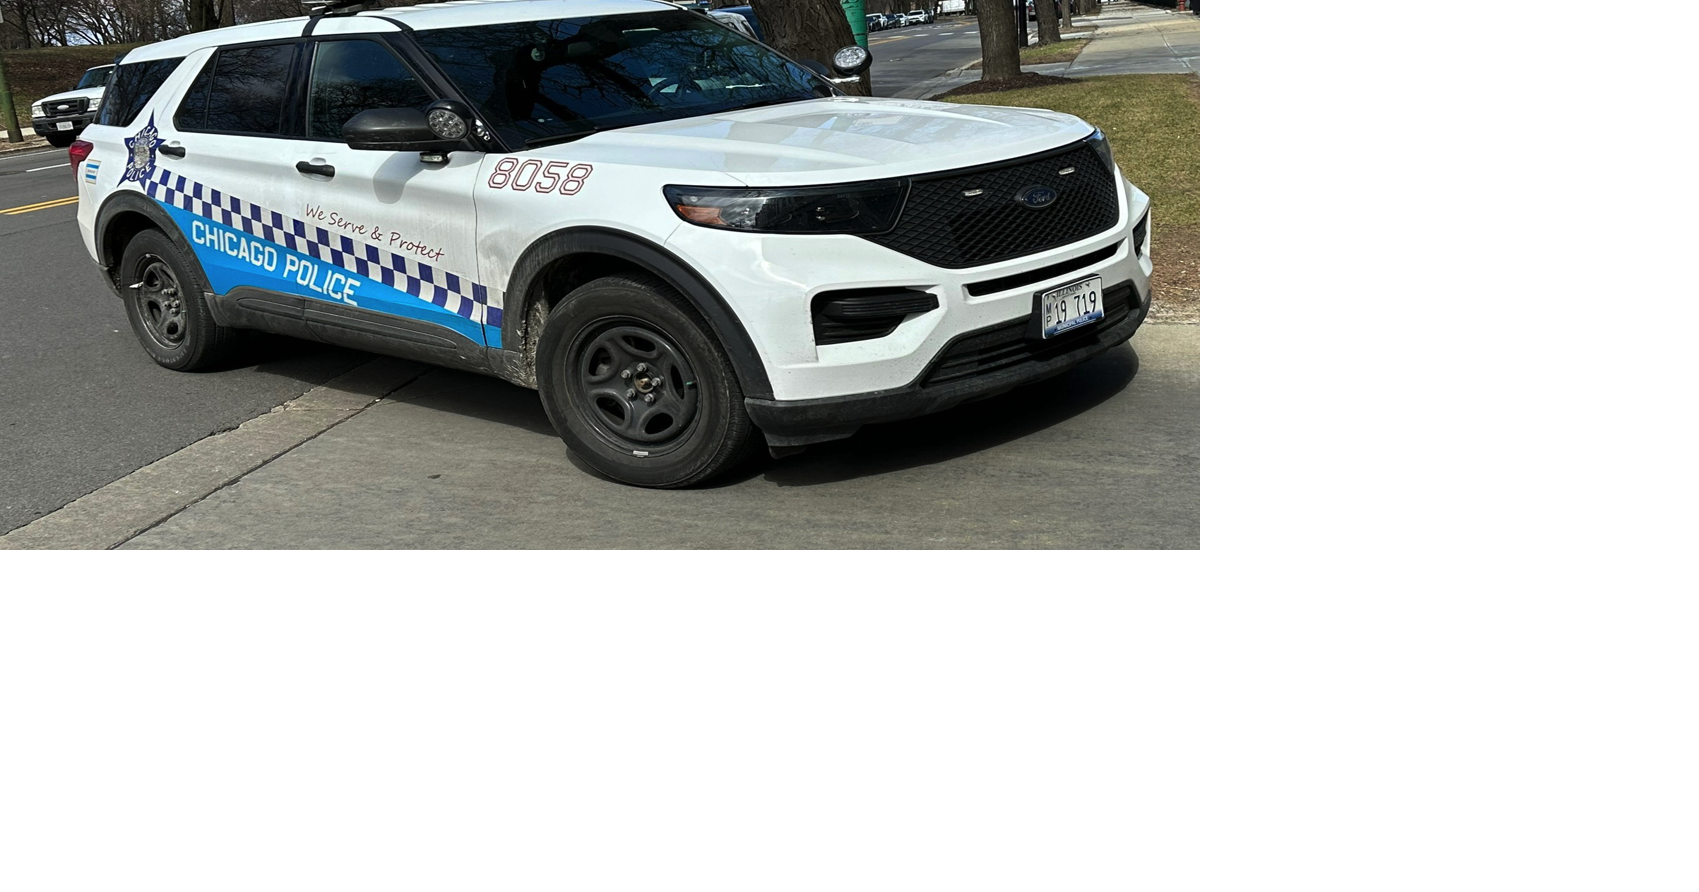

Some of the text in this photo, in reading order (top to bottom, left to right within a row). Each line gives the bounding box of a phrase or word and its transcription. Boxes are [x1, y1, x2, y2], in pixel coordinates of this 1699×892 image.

[129, 126, 157, 148] CHICAGO
[126, 161, 151, 181] POLICE
[488, 157, 593, 196] 8058
[306, 203, 444, 261] We Serve & Protect
[192, 220, 361, 307] CHICAGO POLICE
[1055, 291, 1096, 324] 19 719
[1056, 285, 1082, 298] ILLINOIS
